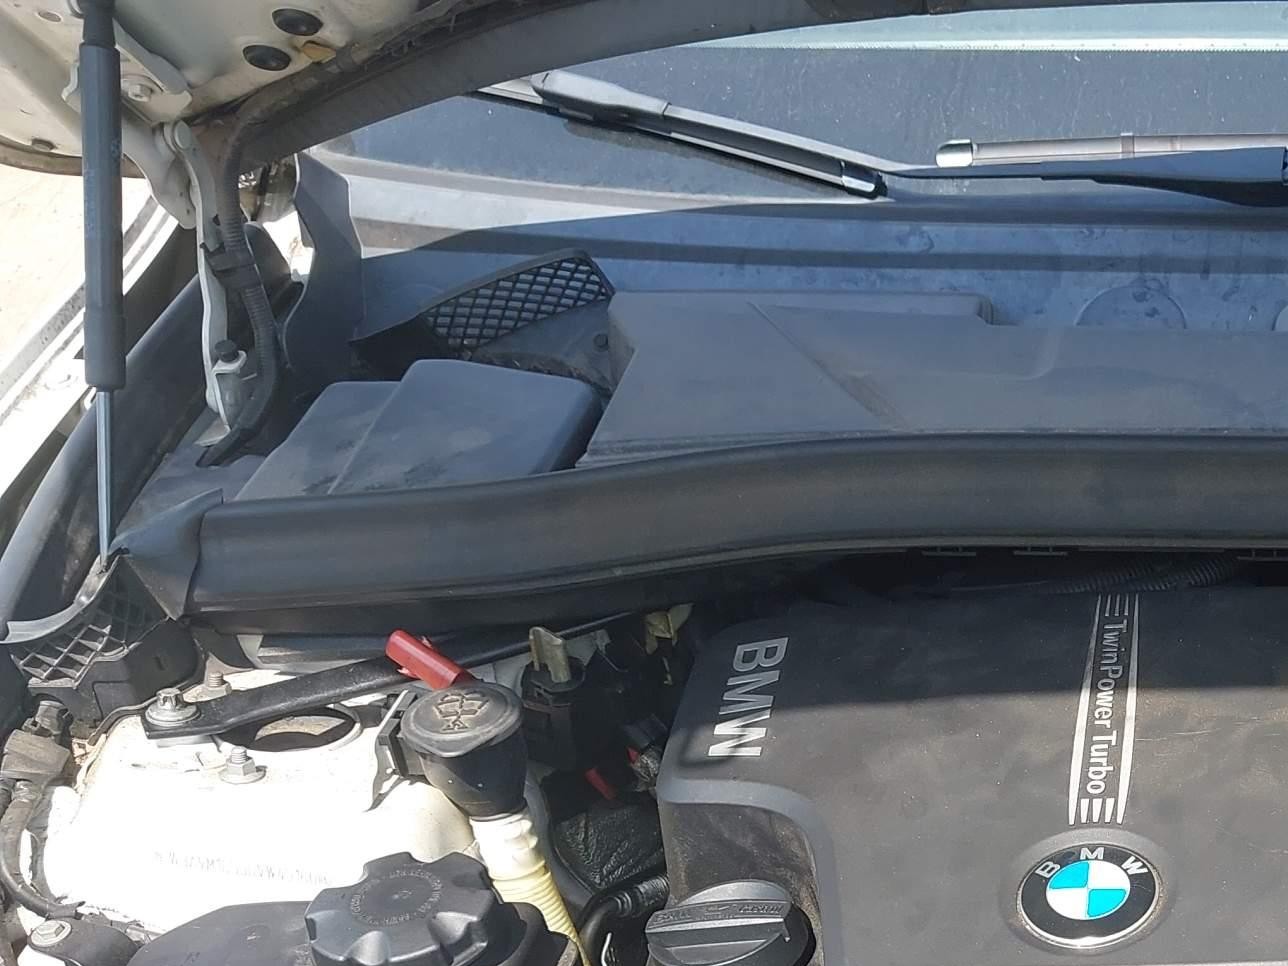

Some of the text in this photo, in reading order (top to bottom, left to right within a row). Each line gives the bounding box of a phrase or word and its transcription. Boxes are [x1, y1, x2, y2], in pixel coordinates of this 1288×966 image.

[708, 636, 789, 757] BMW
[1086, 618, 1128, 795] TwinPower Turbo
[1035, 846, 1149, 879] BMW
